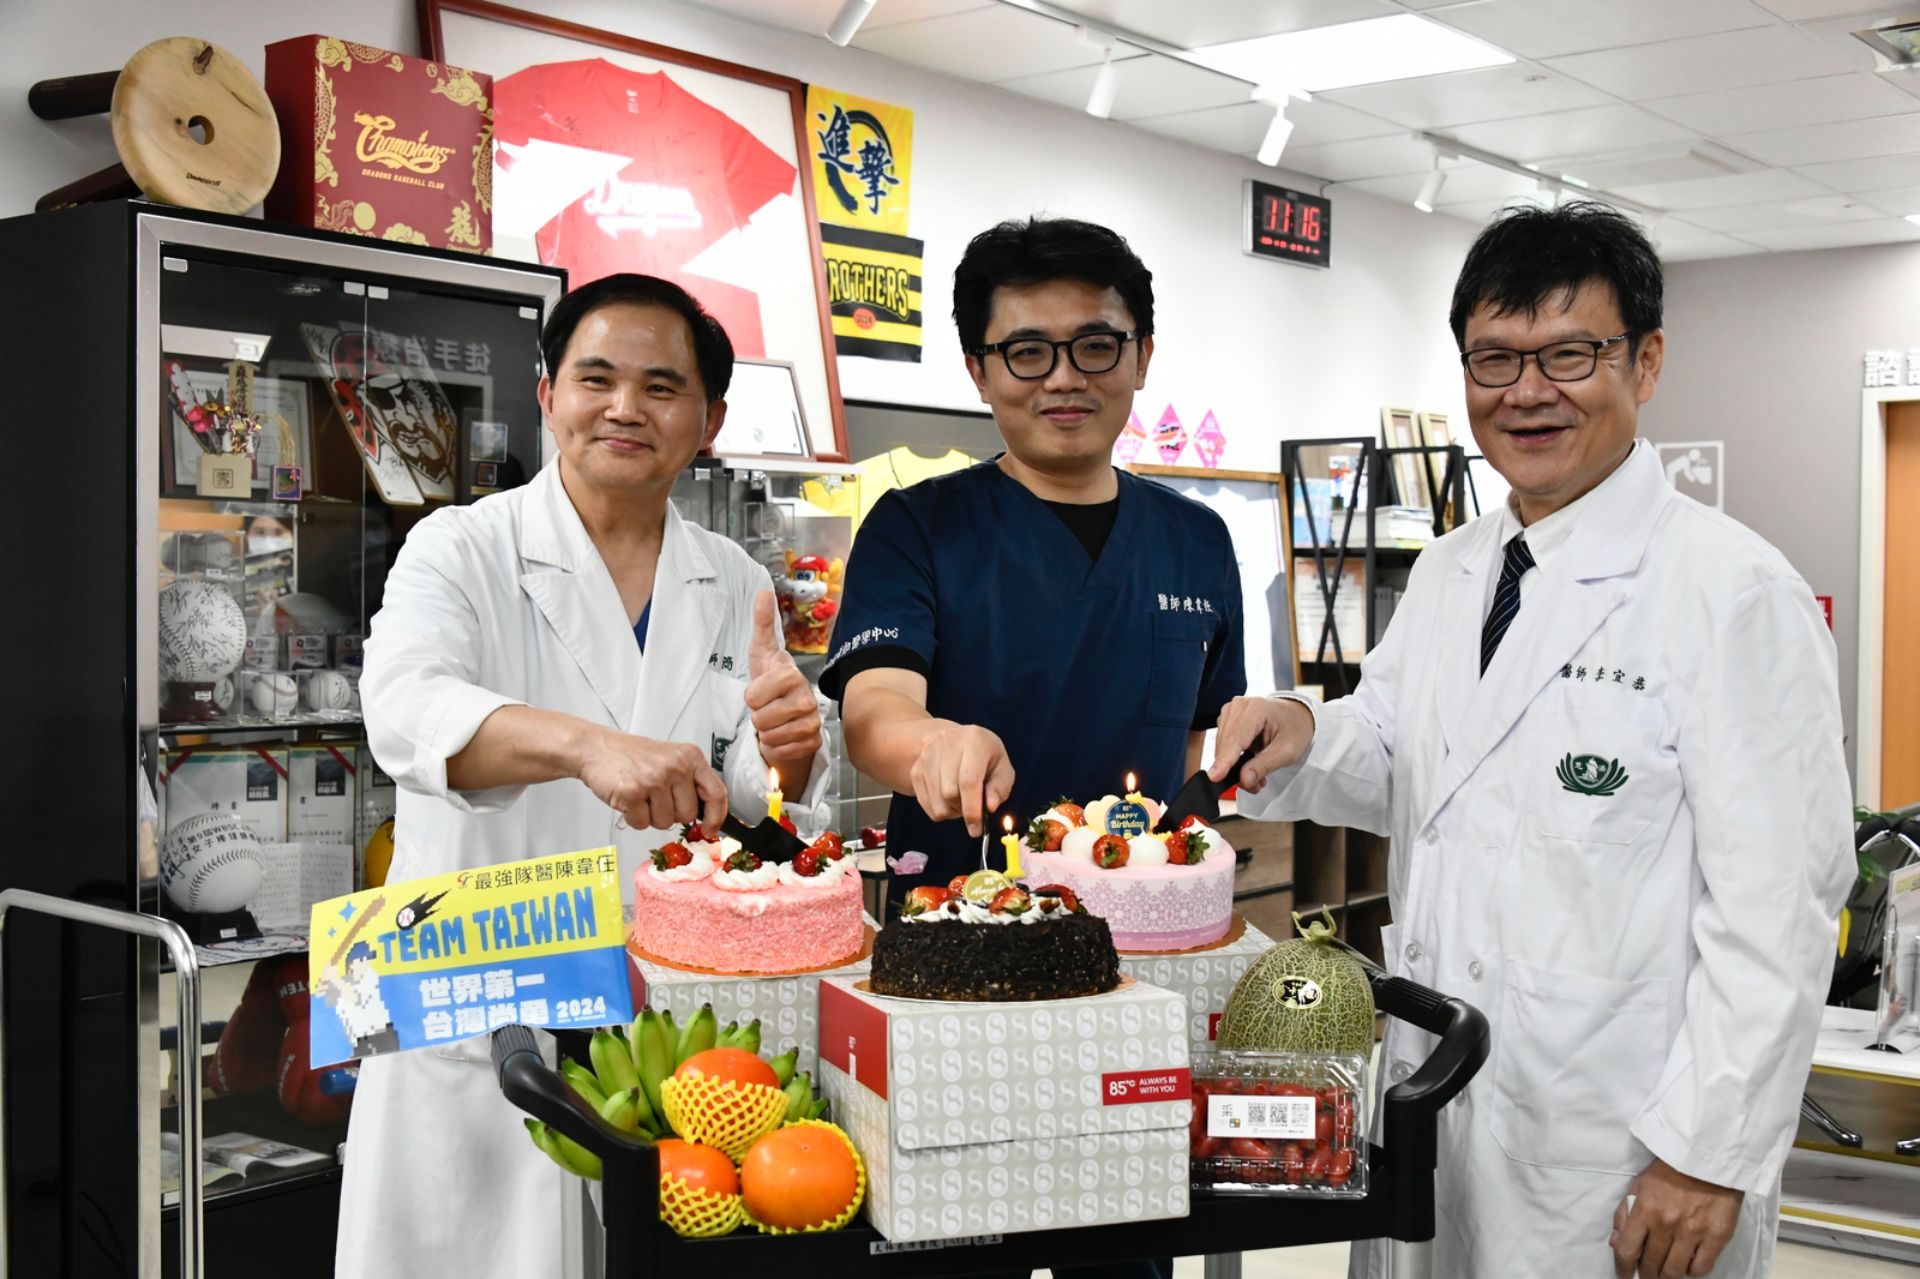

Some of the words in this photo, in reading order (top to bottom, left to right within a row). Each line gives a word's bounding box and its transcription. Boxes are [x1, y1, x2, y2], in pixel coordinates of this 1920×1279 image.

[354, 111, 448, 174] Champions
[817, 104, 900, 214] 進擊
[361, 168, 393, 181] DRAGONS
[393, 174, 427, 188] BASEBALL
[427, 180, 445, 190] CLUB
[444, 199, 480, 247] 龍
[1269, 198, 1321, 242] 11:16
[825, 258, 909, 320] ROTHERS
[1110, 819, 1145, 829] Birthday
[475, 854, 615, 890] 最強隊醫陳韋任
[378, 916, 466, 964] TEAM
[472, 886, 597, 951] TAIWAN
[419, 968, 546, 1008] 世界第一
[556, 995, 607, 1019] 2024
[1139, 1076, 1168, 1086] ALWAYS
[1168, 1075, 1178, 1084] BE
[1139, 1086, 1159, 1095] WITH
[1159, 1084, 1176, 1093] YOU
